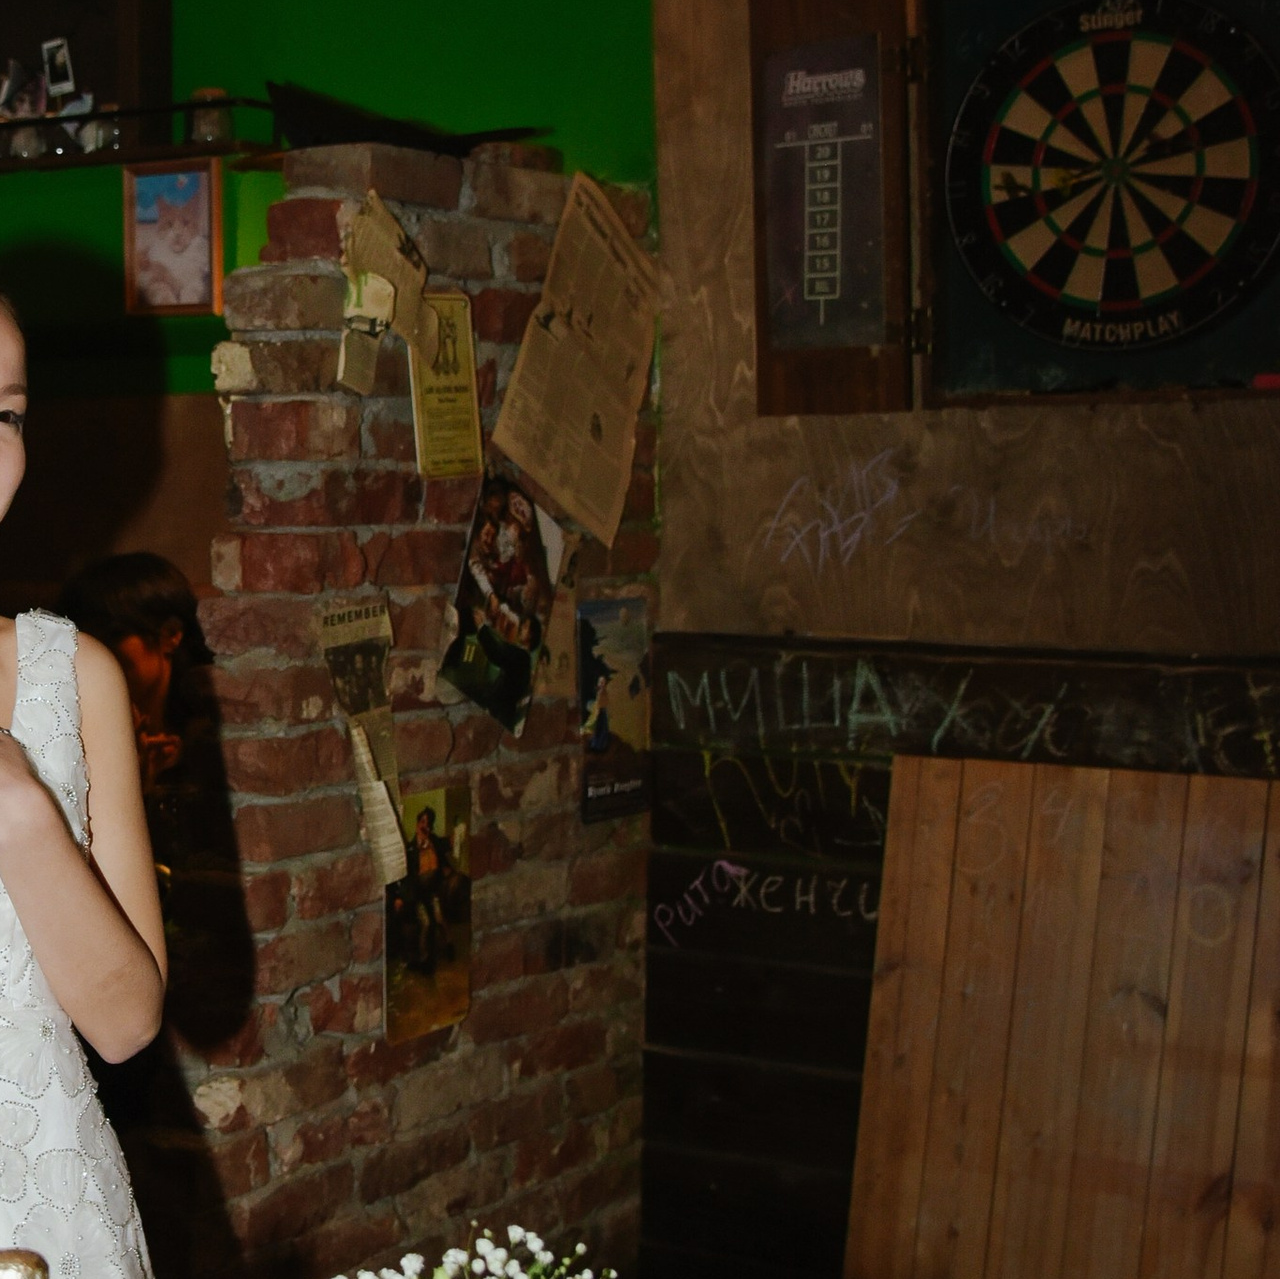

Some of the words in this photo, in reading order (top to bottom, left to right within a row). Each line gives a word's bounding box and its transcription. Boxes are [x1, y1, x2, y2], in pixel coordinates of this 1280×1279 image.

[1078, 9, 1144, 33] Stinger
[784, 67, 867, 95] Harrows
[815, 212, 831, 226] 17
[1061, 309, 1183, 344] MATCHPLAY
[322, 605, 386, 628] REMEMBER
